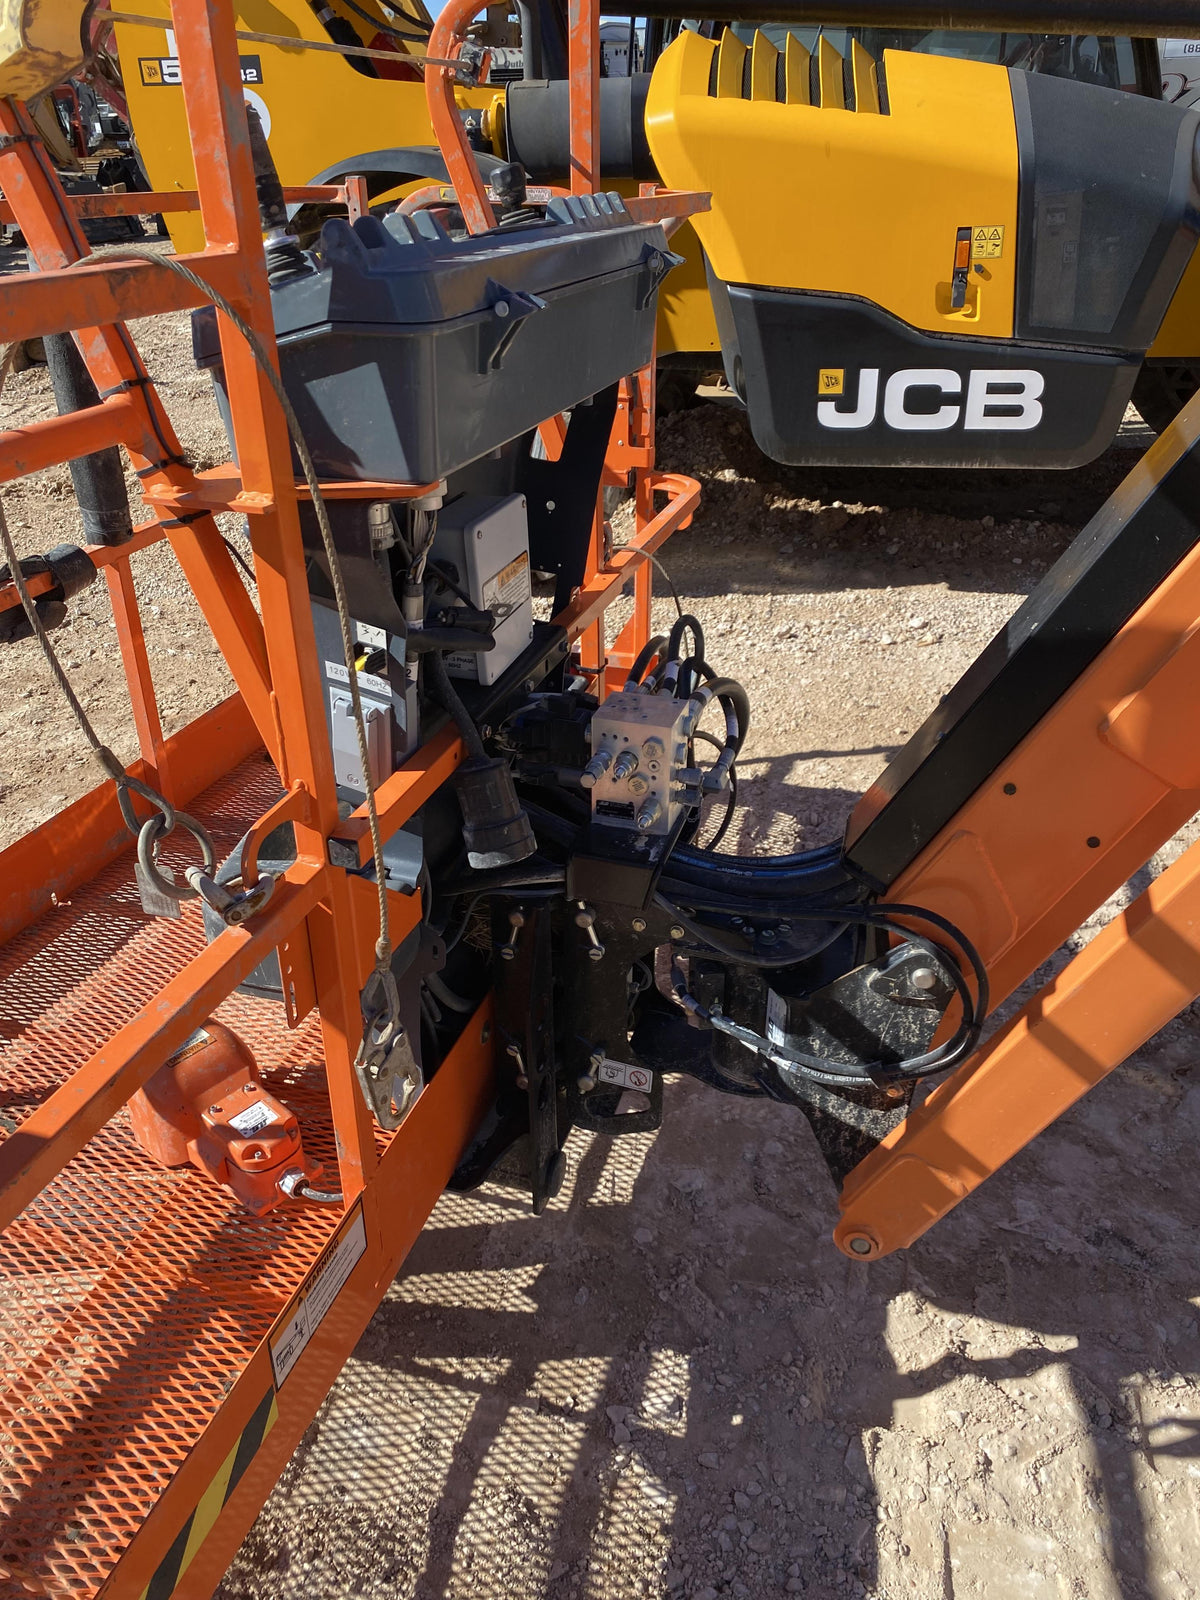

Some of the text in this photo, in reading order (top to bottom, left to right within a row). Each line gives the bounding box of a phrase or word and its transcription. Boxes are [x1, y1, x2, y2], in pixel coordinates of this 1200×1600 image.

[817, 368, 1045, 430] JCB
[824, 375, 840, 388] JCB
[304, 1239, 340, 1293] WARNING
